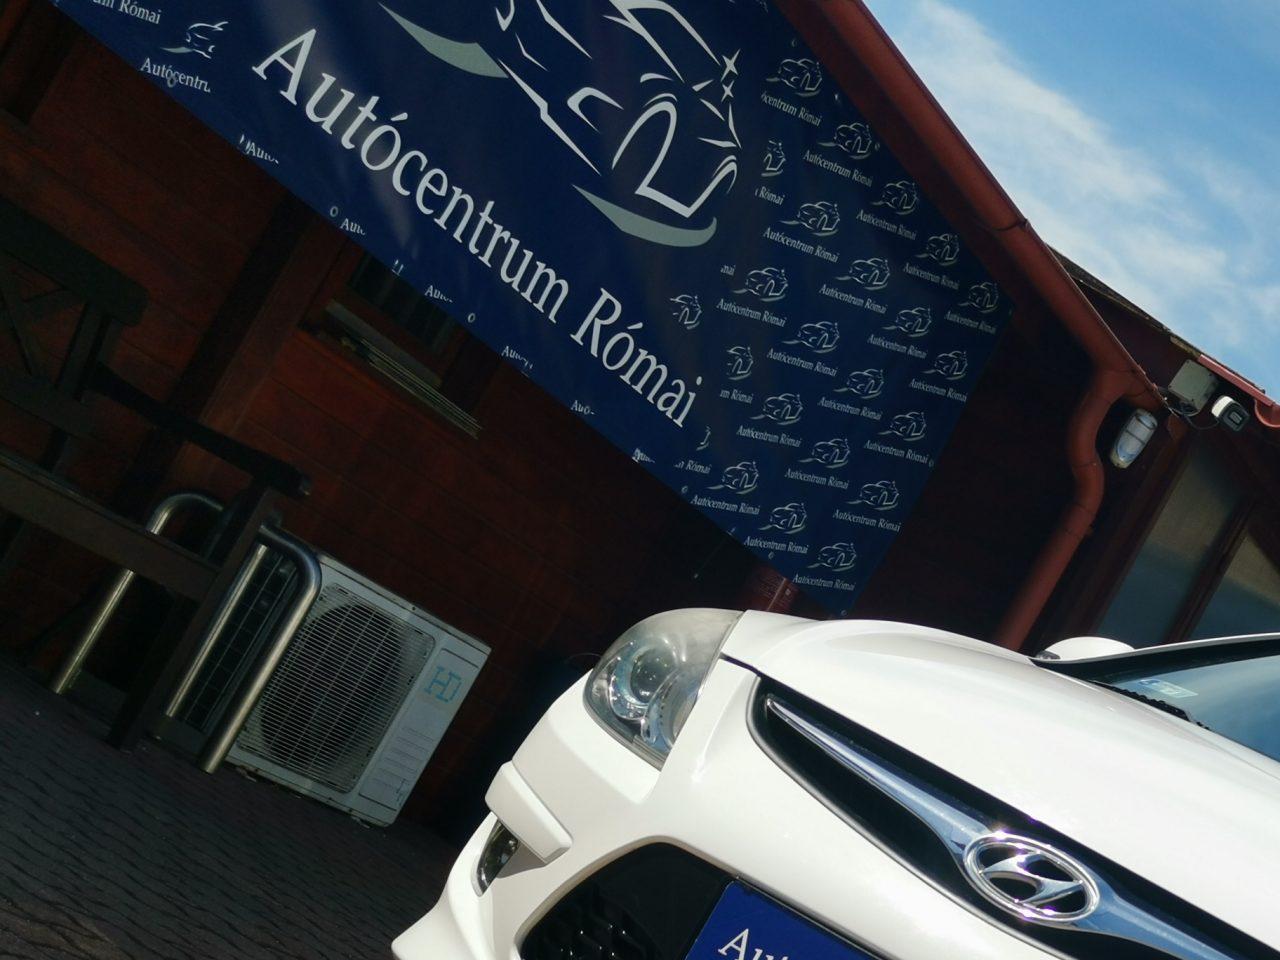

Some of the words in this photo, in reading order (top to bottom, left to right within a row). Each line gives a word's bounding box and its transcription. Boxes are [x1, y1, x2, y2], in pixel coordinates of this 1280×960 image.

[118, 0, 162, 24] Római
[798, 106, 823, 127] Római
[803, 150, 851, 177] Autócentrum
[760, 186, 785, 206] Római
[252, 28, 570, 324] Autócentrum
[570, 288, 703, 428] Római
[763, 227, 814, 255] Autócentrum
[815, 246, 840, 263] Római
[819, 284, 864, 307] Autócentrum
[717, 299, 761, 320] Autócentrum
[767, 348, 814, 370] Autócentrum
